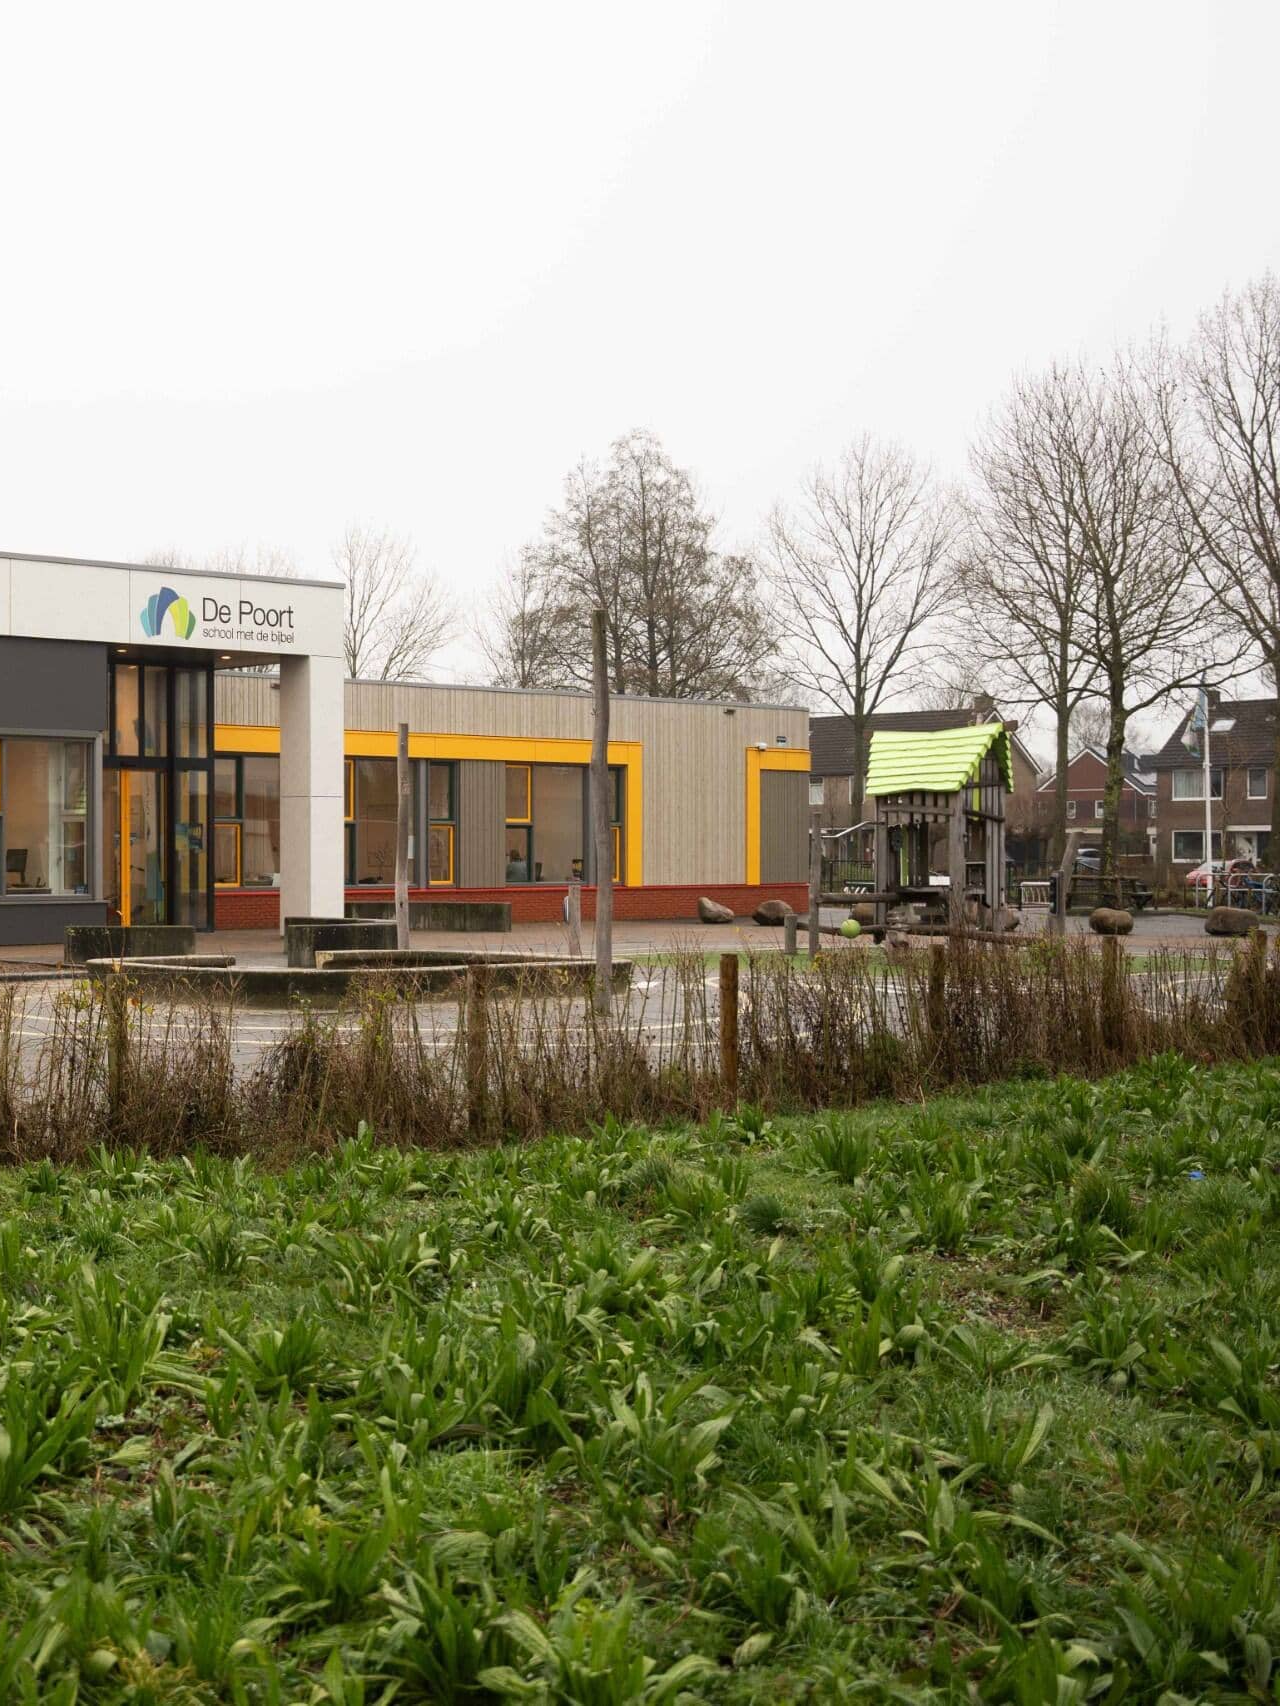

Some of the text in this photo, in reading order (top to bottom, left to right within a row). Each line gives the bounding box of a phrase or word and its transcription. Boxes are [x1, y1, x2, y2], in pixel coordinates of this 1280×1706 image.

[202, 597, 294, 629] De Poort
[202, 627, 295, 645] school met de bijbel
